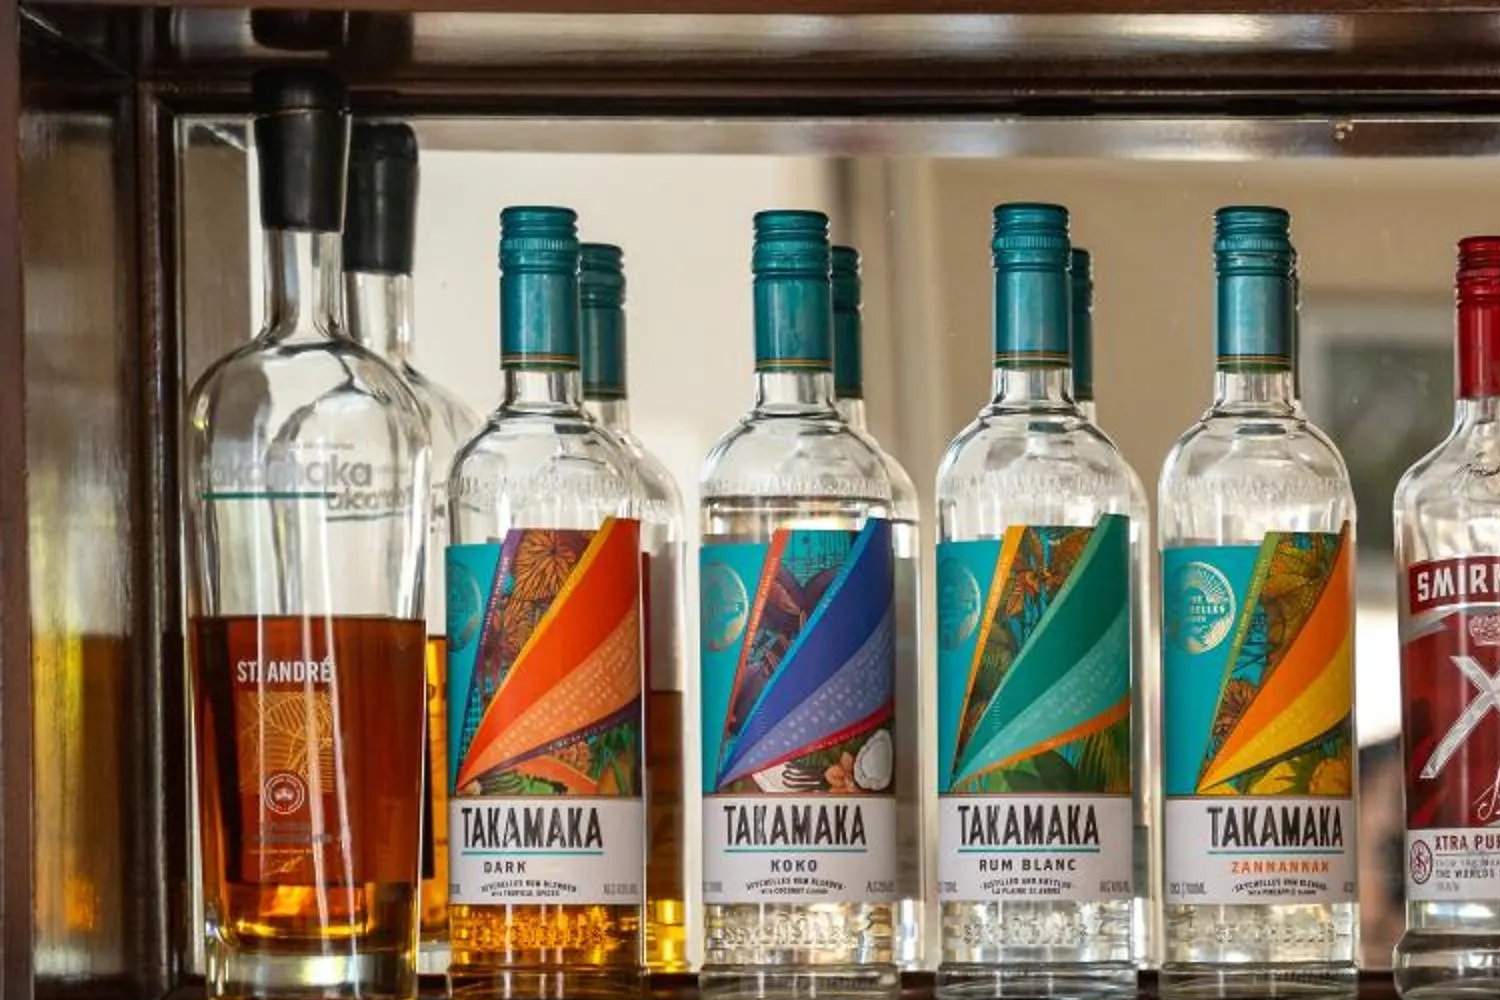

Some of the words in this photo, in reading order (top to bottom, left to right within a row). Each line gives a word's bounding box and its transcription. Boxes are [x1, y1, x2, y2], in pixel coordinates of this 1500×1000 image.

[267, 655, 334, 683] ANDRÉ
[461, 807, 604, 849] TAKAMAKA
[723, 805, 867, 846] TAKAMAKA
[957, 804, 1100, 846] TAKAMAKA
[1206, 806, 1344, 847] TAKAMAKA
[1434, 834, 1467, 851] XTRA
[483, 860, 527, 874] DARK
[770, 859, 819, 873] KOKO
[979, 859, 1014, 872] RUM
[1021, 859, 1077, 872] BLANC
